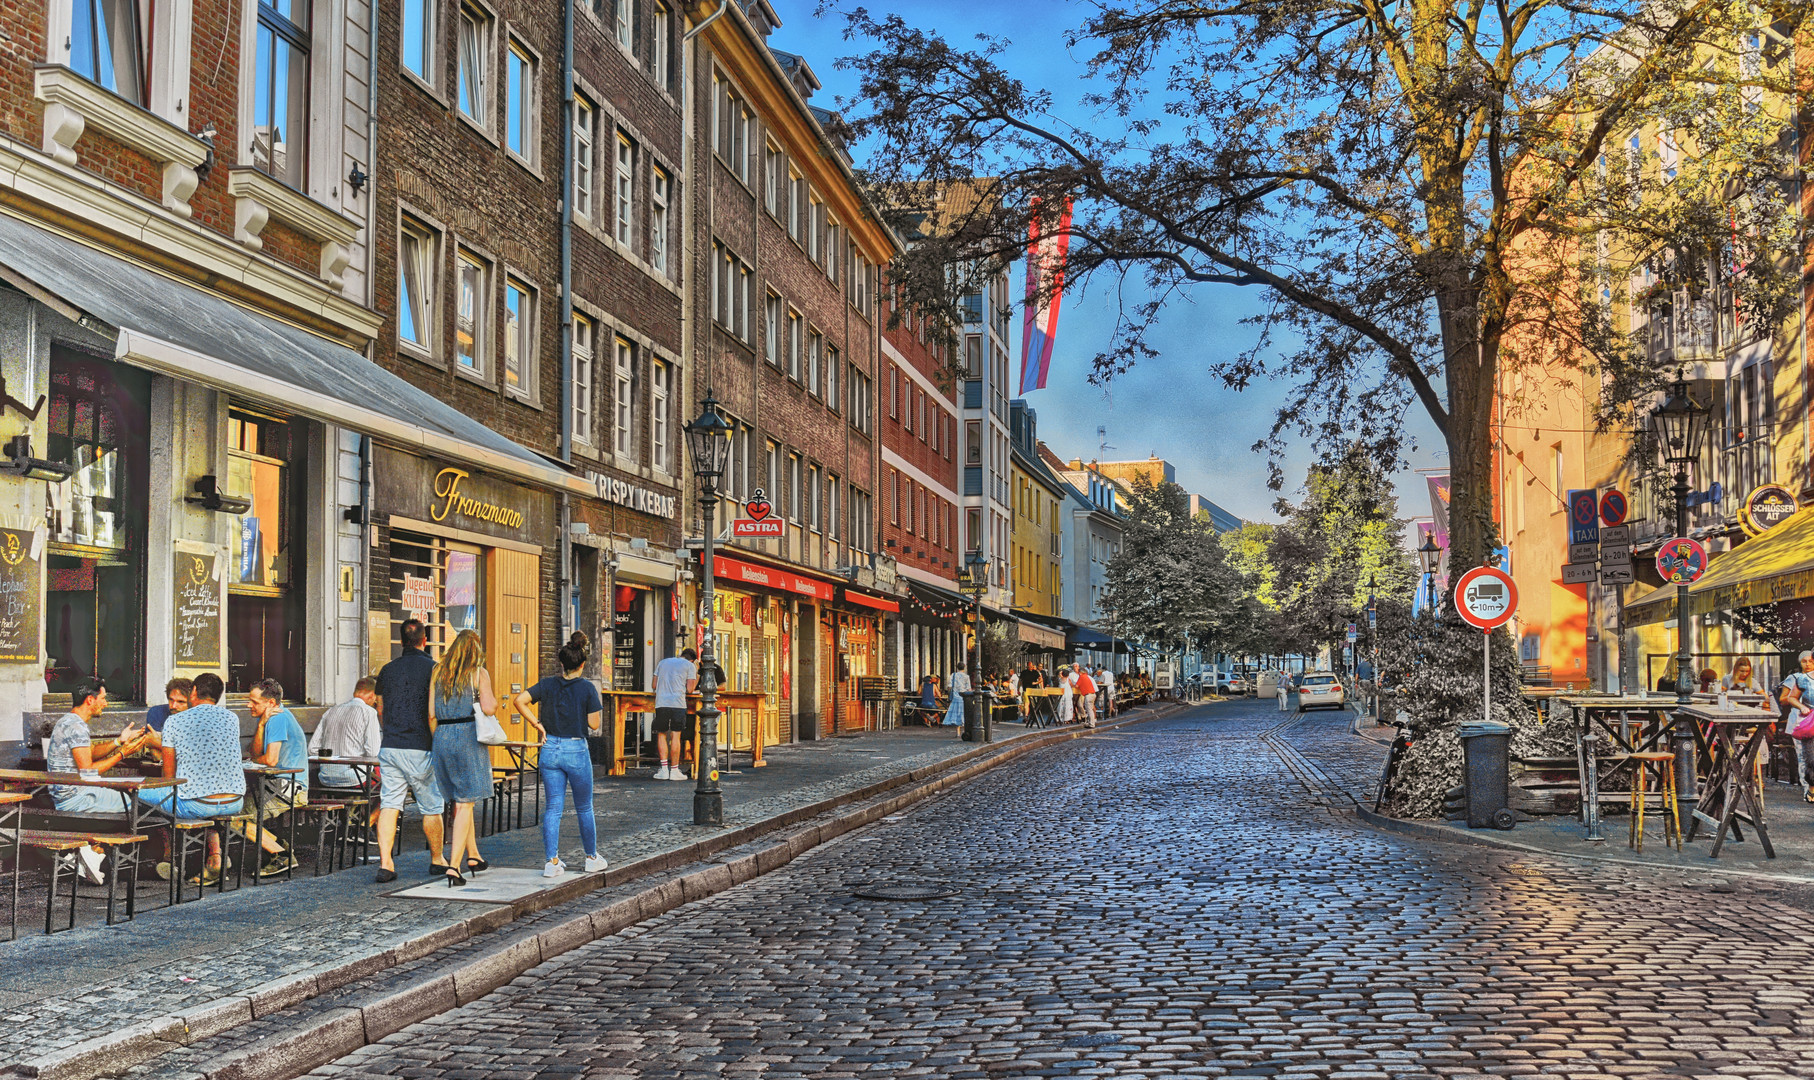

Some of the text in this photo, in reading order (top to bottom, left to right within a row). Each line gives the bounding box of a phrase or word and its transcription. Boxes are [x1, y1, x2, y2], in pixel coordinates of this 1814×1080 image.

[590, 471, 635, 508] KRISPY
[430, 467, 524, 529] Franzmann
[1752, 503, 1794, 513] SCHLÖSSER
[1766, 512, 1780, 520] ALT
[737, 523, 779, 532] ASTRA
[1575, 527, 1597, 542] TAXI
[405, 575, 434, 593] Jugend
[403, 592, 436, 611] KULTUR
[1479, 603, 1495, 611] 10m
